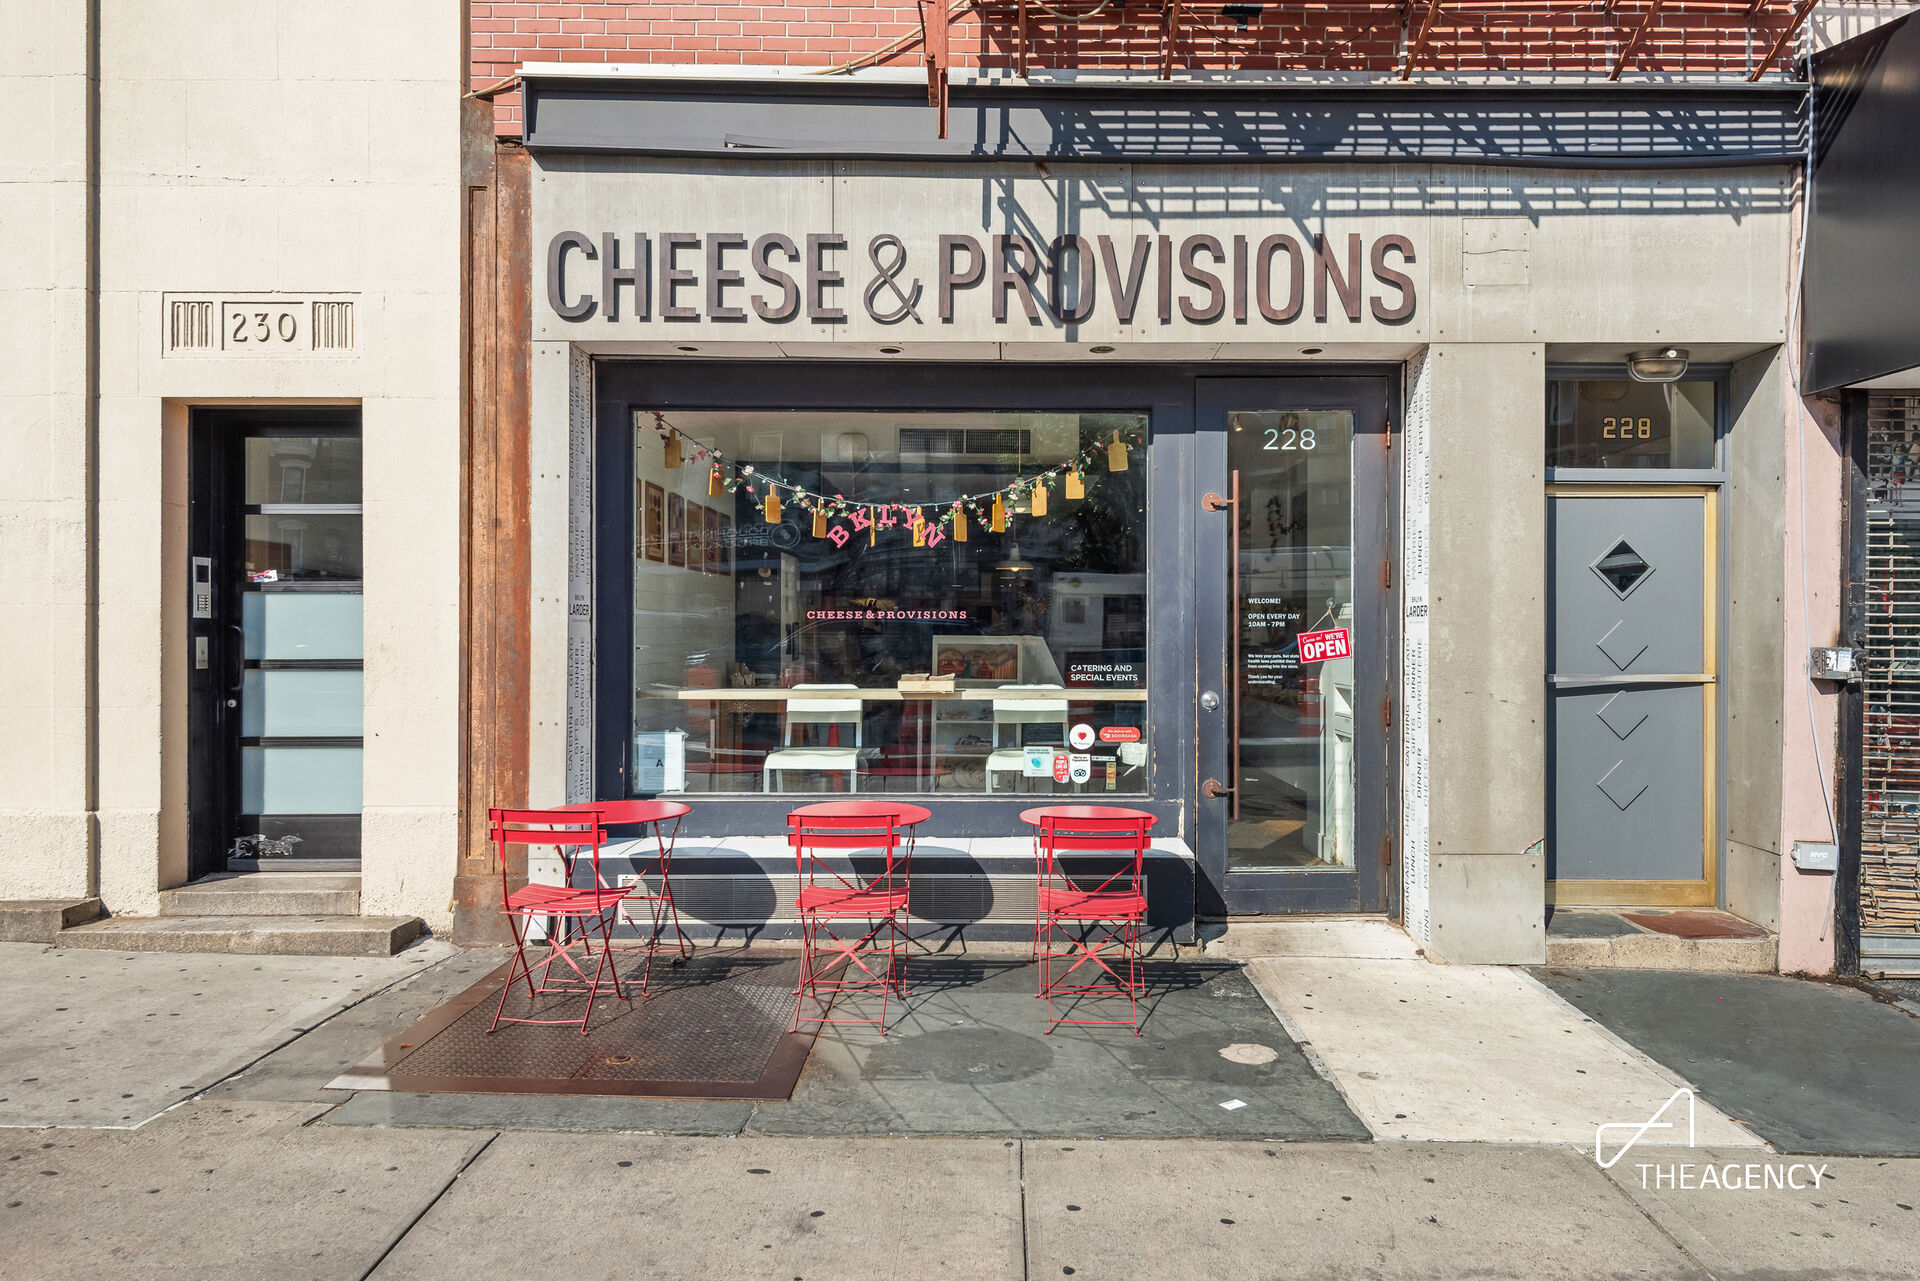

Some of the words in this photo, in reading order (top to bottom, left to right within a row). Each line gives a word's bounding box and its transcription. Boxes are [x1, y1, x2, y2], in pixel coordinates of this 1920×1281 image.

[546, 231, 845, 318] CHEESE
[863, 233, 921, 317] &
[938, 233, 1417, 319] PROVISIONS
[232, 312, 297, 342] 230
[1603, 416, 1651, 439] 228
[1263, 428, 1316, 450] 228
[826, 505, 946, 548] BKLYN
[569, 603, 589, 615] LARDER
[1406, 605, 1428, 617] LARDER
[1302, 636, 1316, 644] Come
[1324, 631, 1345, 641] WE'RE
[1303, 639, 1348, 660] OPEN
[1070, 664, 1112, 672] CATERING
[1113, 664, 1132, 672] AND
[656, 759, 664, 767] A
